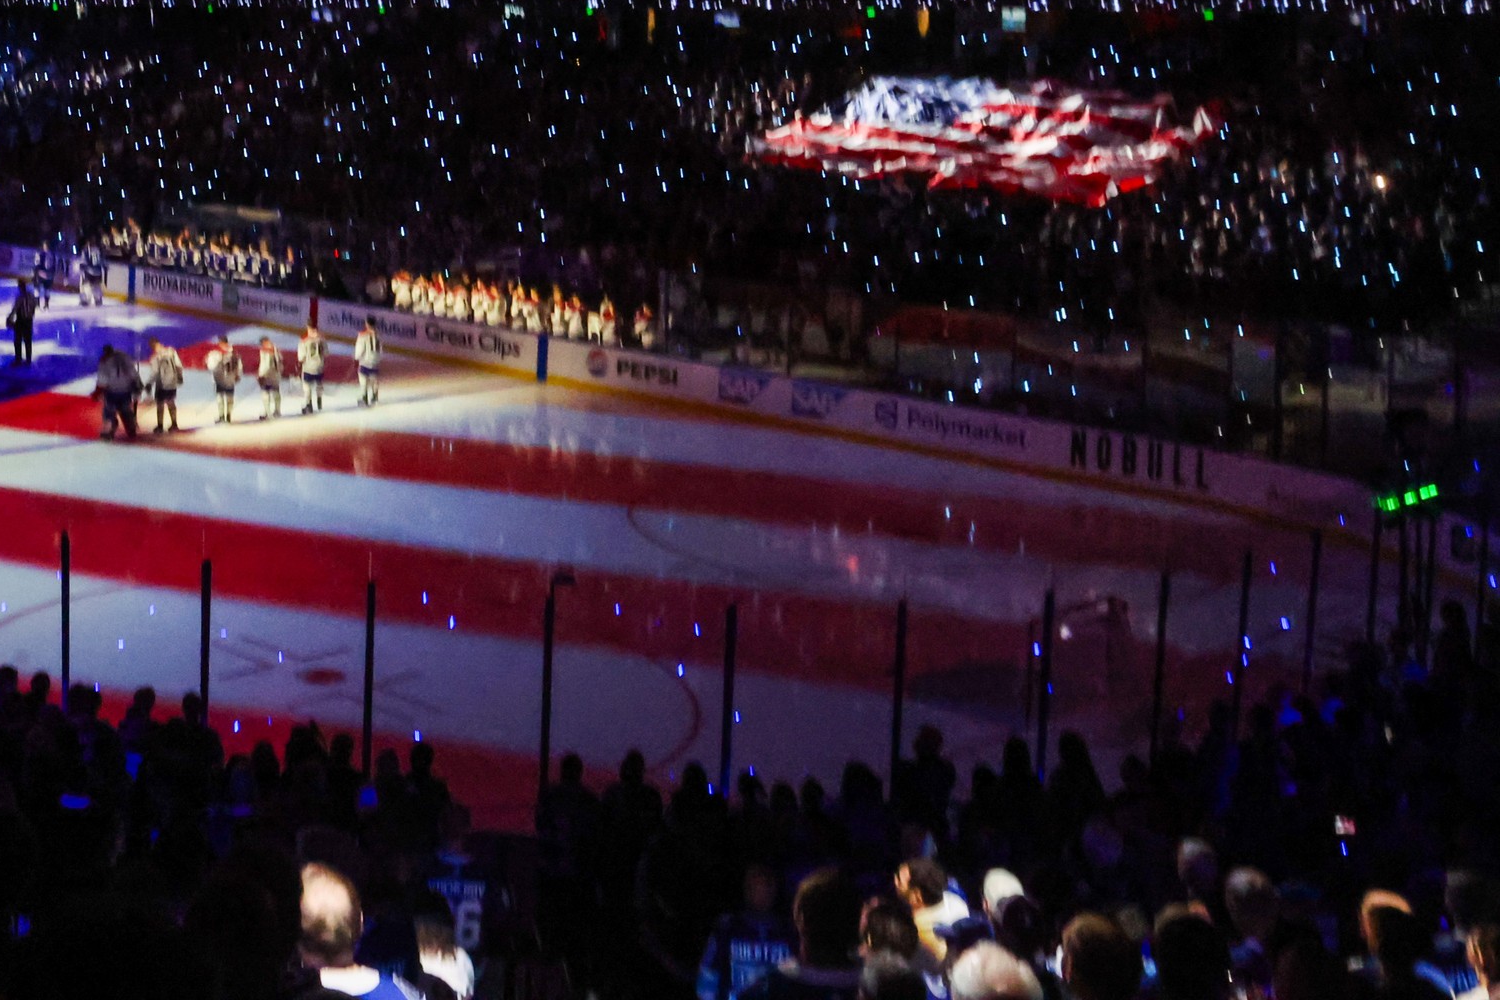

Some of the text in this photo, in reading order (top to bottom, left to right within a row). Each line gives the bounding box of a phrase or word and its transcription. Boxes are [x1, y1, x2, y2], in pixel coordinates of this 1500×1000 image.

[143, 271, 214, 299] BODYARMOR
[424, 320, 521, 360] Great Clips
[616, 358, 679, 386] PEPSI
[907, 402, 1026, 448] Polymarket
[1070, 429, 1208, 490] NOBULL
